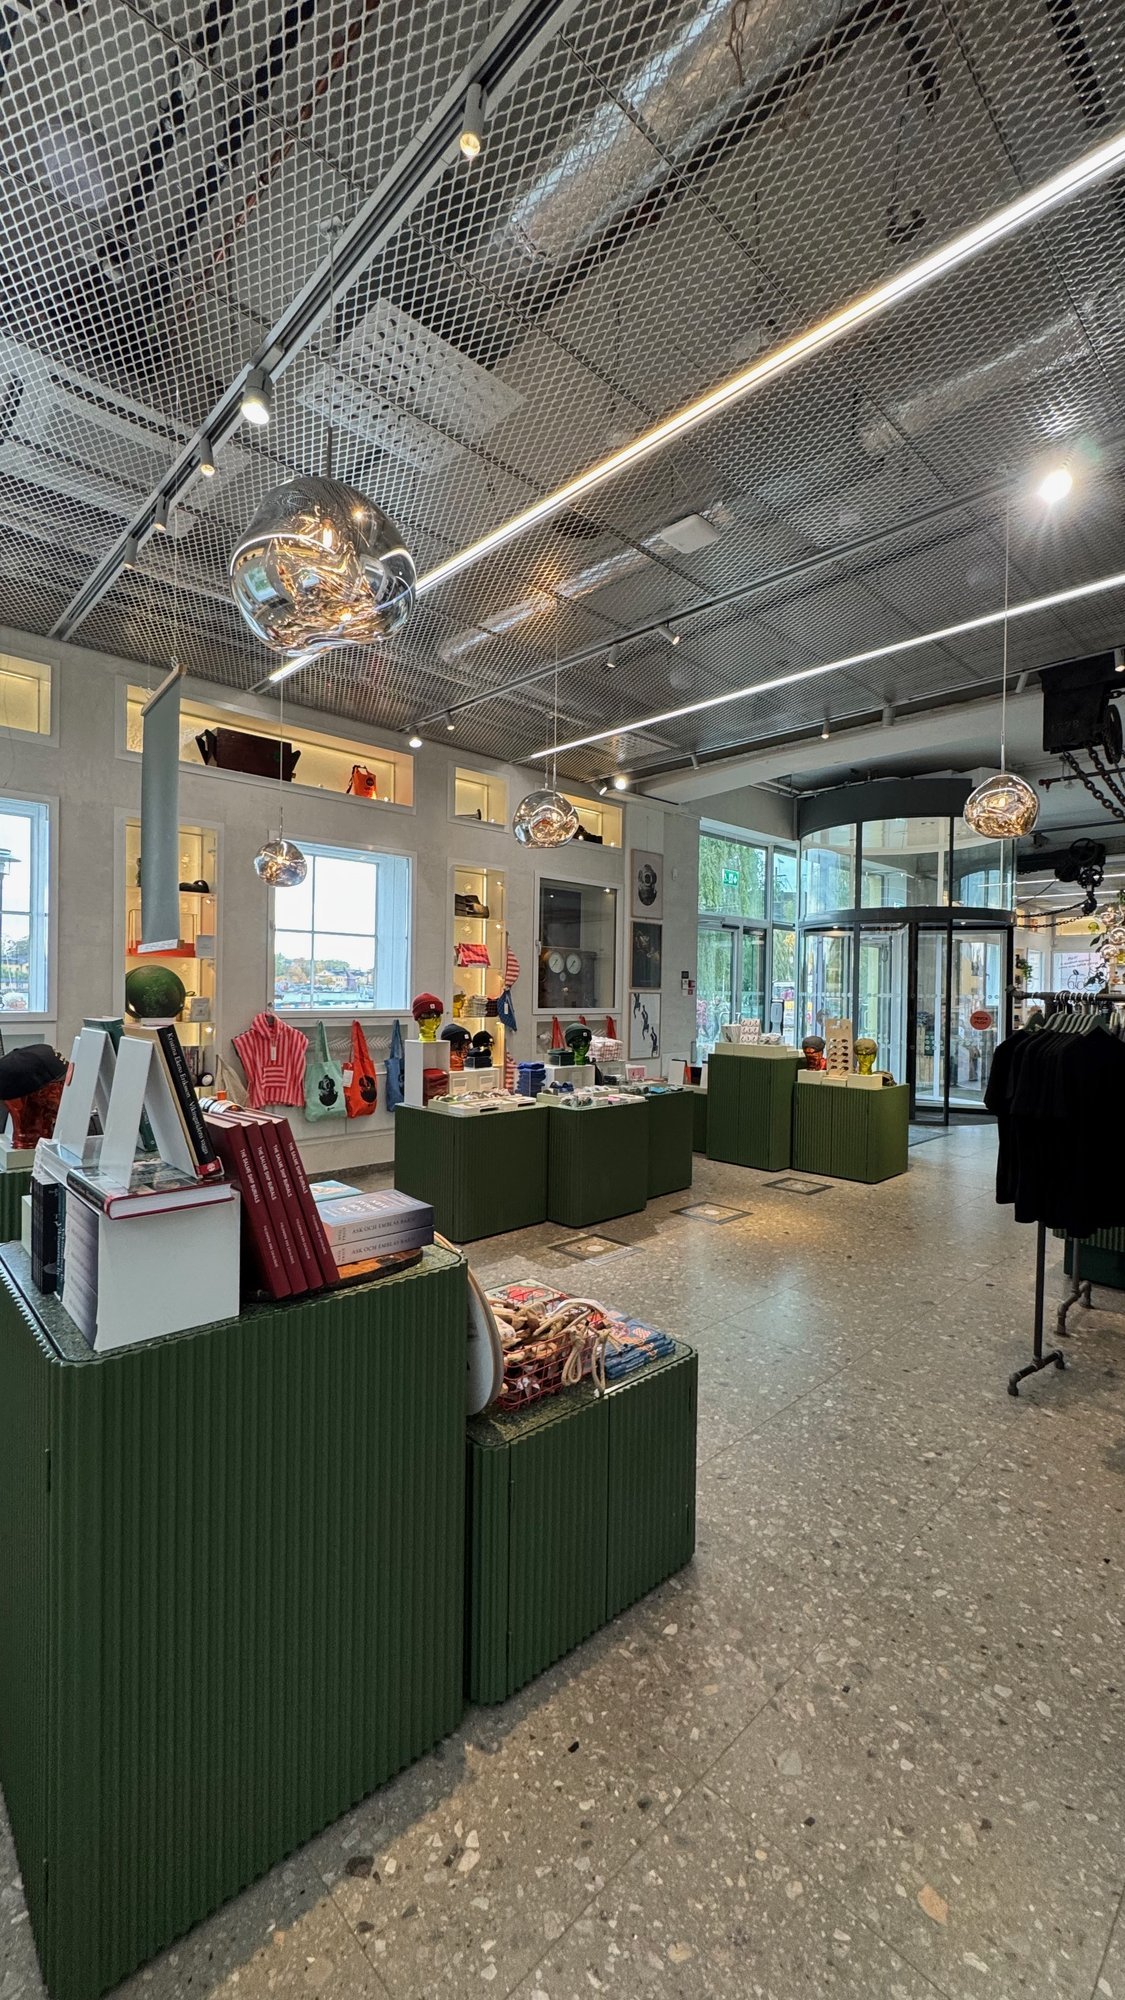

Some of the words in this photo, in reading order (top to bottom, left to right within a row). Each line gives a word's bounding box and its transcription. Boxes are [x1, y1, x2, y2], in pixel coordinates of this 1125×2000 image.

[167, 1032, 177, 1056] Kristina
[180, 1073, 191, 1098] Eriksson
[250, 1184, 260, 1204] BURIALS
[267, 1181, 277, 1200] BURIALS
[283, 1178, 292, 1198] BURIALS
[299, 1176, 308, 1194] BURIALS
